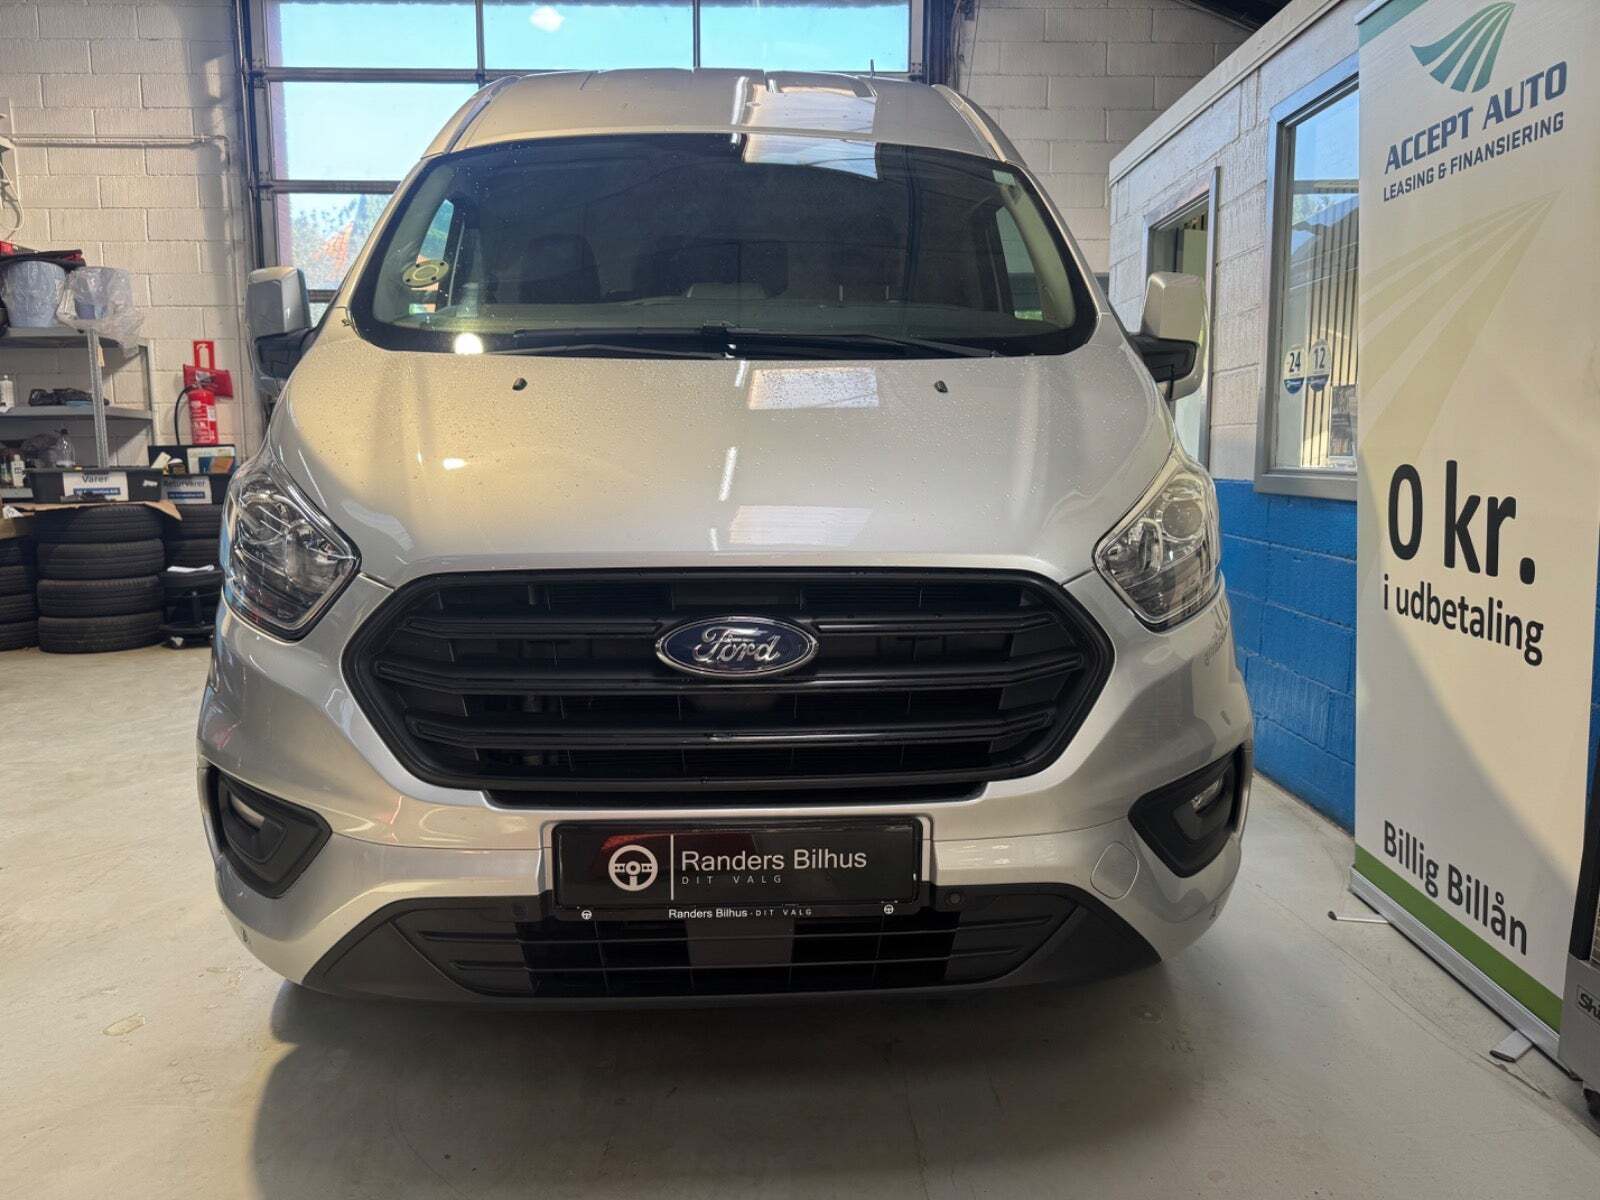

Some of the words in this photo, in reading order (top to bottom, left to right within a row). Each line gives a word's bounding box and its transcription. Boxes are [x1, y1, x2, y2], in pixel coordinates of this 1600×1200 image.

[1384, 106, 1473, 175] ACCEPT
[1482, 61, 1567, 130] AUTO
[1384, 167, 1434, 202] LEASING
[1438, 162, 1447, 180] &
[1450, 111, 1564, 175] FINANSIERING
[1288, 351, 1301, 373] 24
[1314, 347, 1326, 370] 12
[1388, 464, 1423, 561] 0
[1444, 460, 1536, 585] kr.
[1384, 573, 1389, 611] i
[1396, 581, 1544, 666] udbetaling
[692, 626, 782, 663] Ford
[681, 850, 785, 872] Randers
[793, 848, 867, 869] Bilhus
[681, 876, 714, 885] DIT
[733, 875, 782, 884] VALG
[1384, 820, 1440, 898] Billig
[1448, 863, 1528, 956] Billån
[668, 908, 713, 919] Randers
[715, 907, 748, 918] Bilhus
[782, 908, 812, 916] VALG
